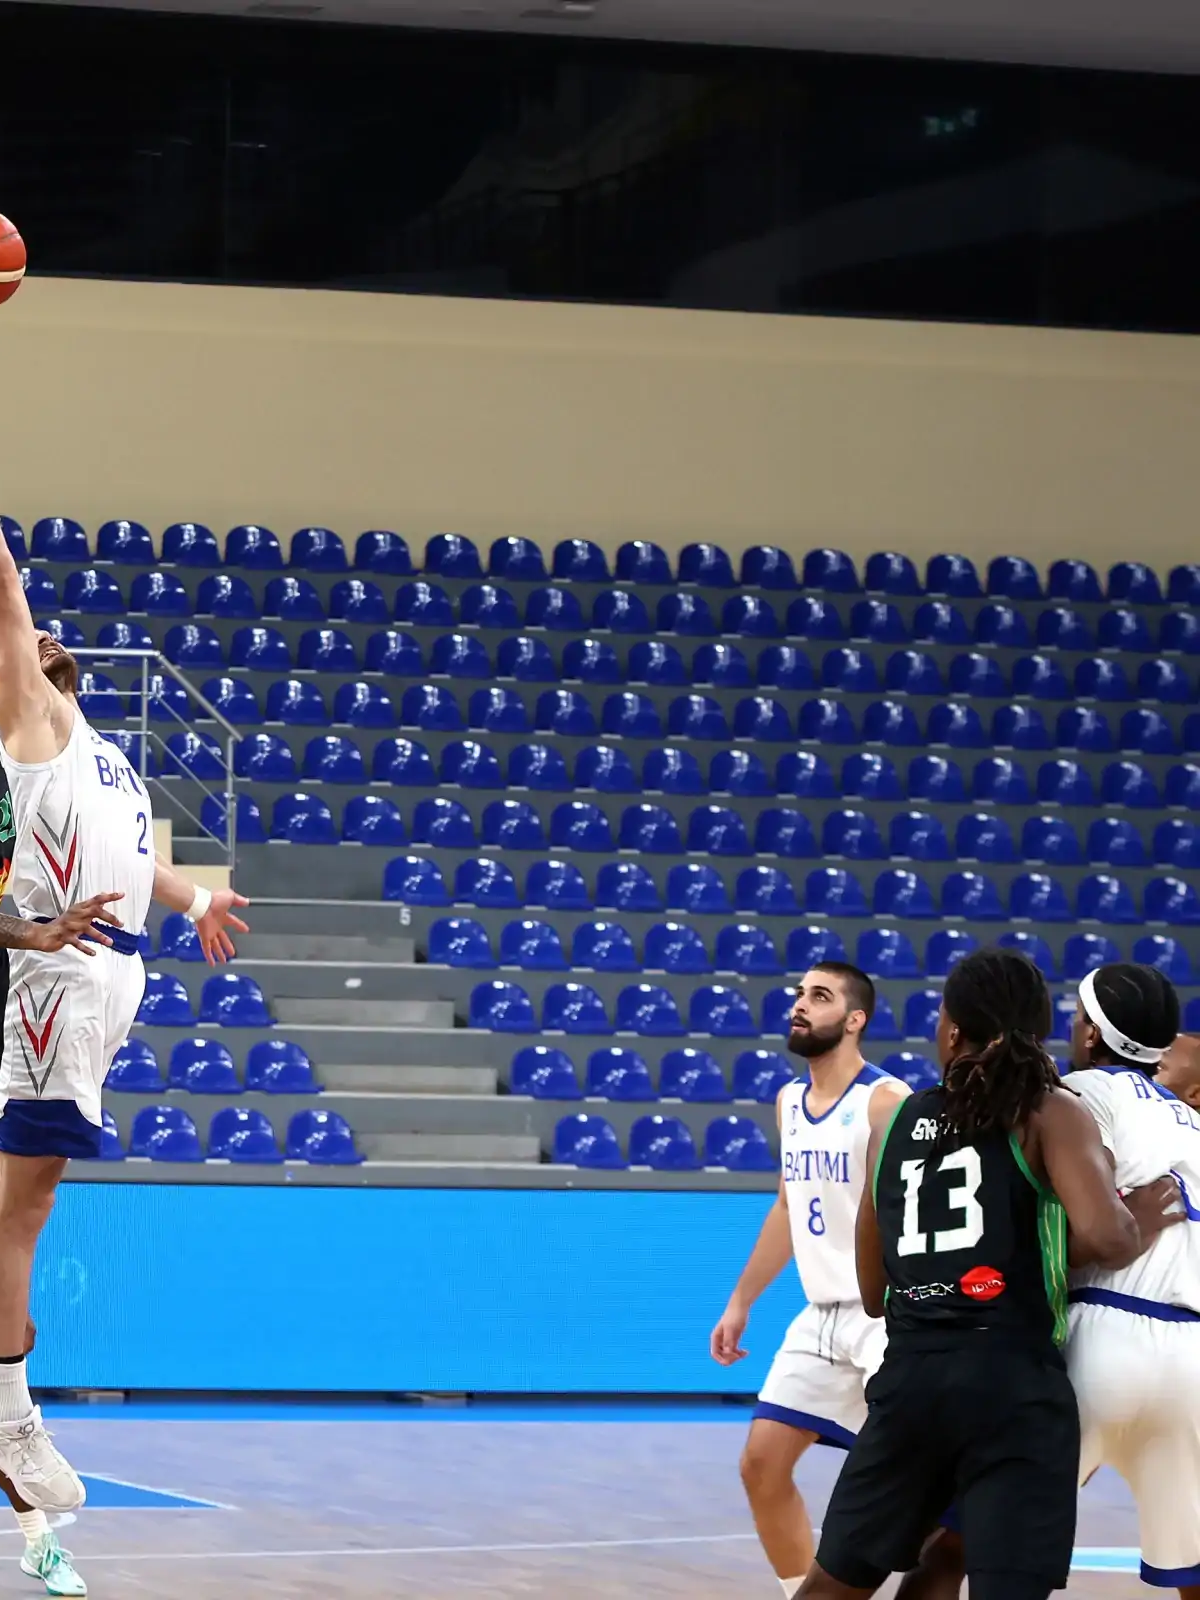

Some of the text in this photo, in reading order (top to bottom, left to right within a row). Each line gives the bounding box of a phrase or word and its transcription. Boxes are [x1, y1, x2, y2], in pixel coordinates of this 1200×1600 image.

[136, 811, 148, 855] 2
[785, 1150, 850, 1183] BATUMI
[808, 1197, 826, 1236] 8
[897, 1146, 984, 1257] 13
